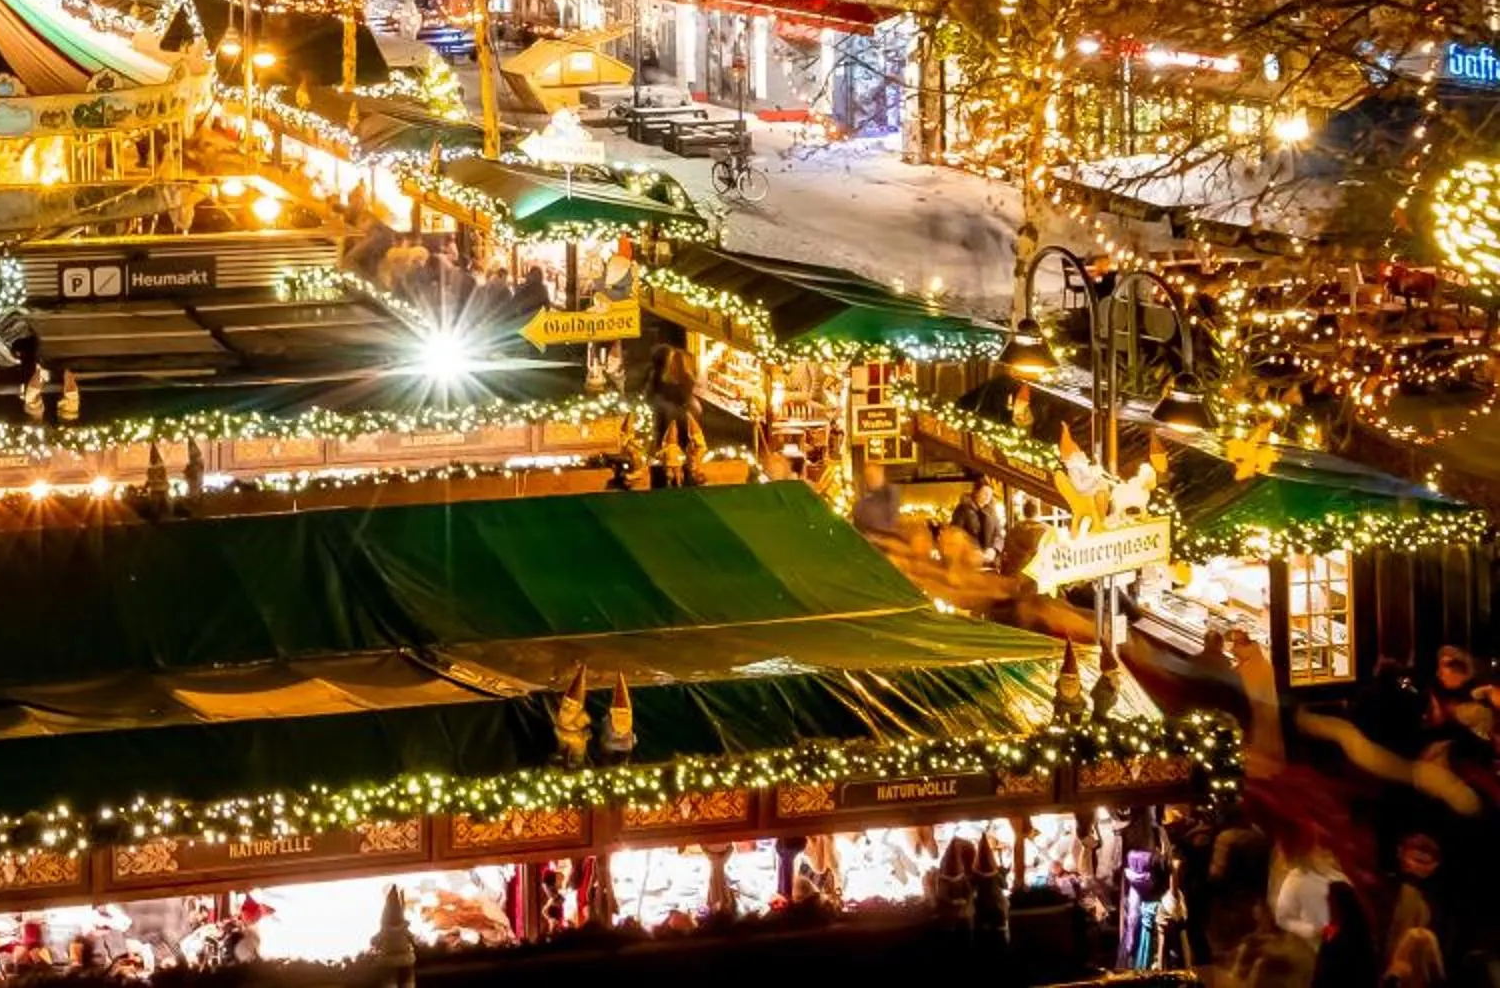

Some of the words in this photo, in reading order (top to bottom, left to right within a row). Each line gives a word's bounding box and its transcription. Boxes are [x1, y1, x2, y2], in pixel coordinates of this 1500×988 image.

[1449, 43, 1500, 82] Gaff
[131, 269, 208, 287] Heumarkt
[543, 315, 634, 337] Goldgasse
[877, 779, 957, 801] NATURWOLLE
[229, 835, 313, 859] NATURFELLE
